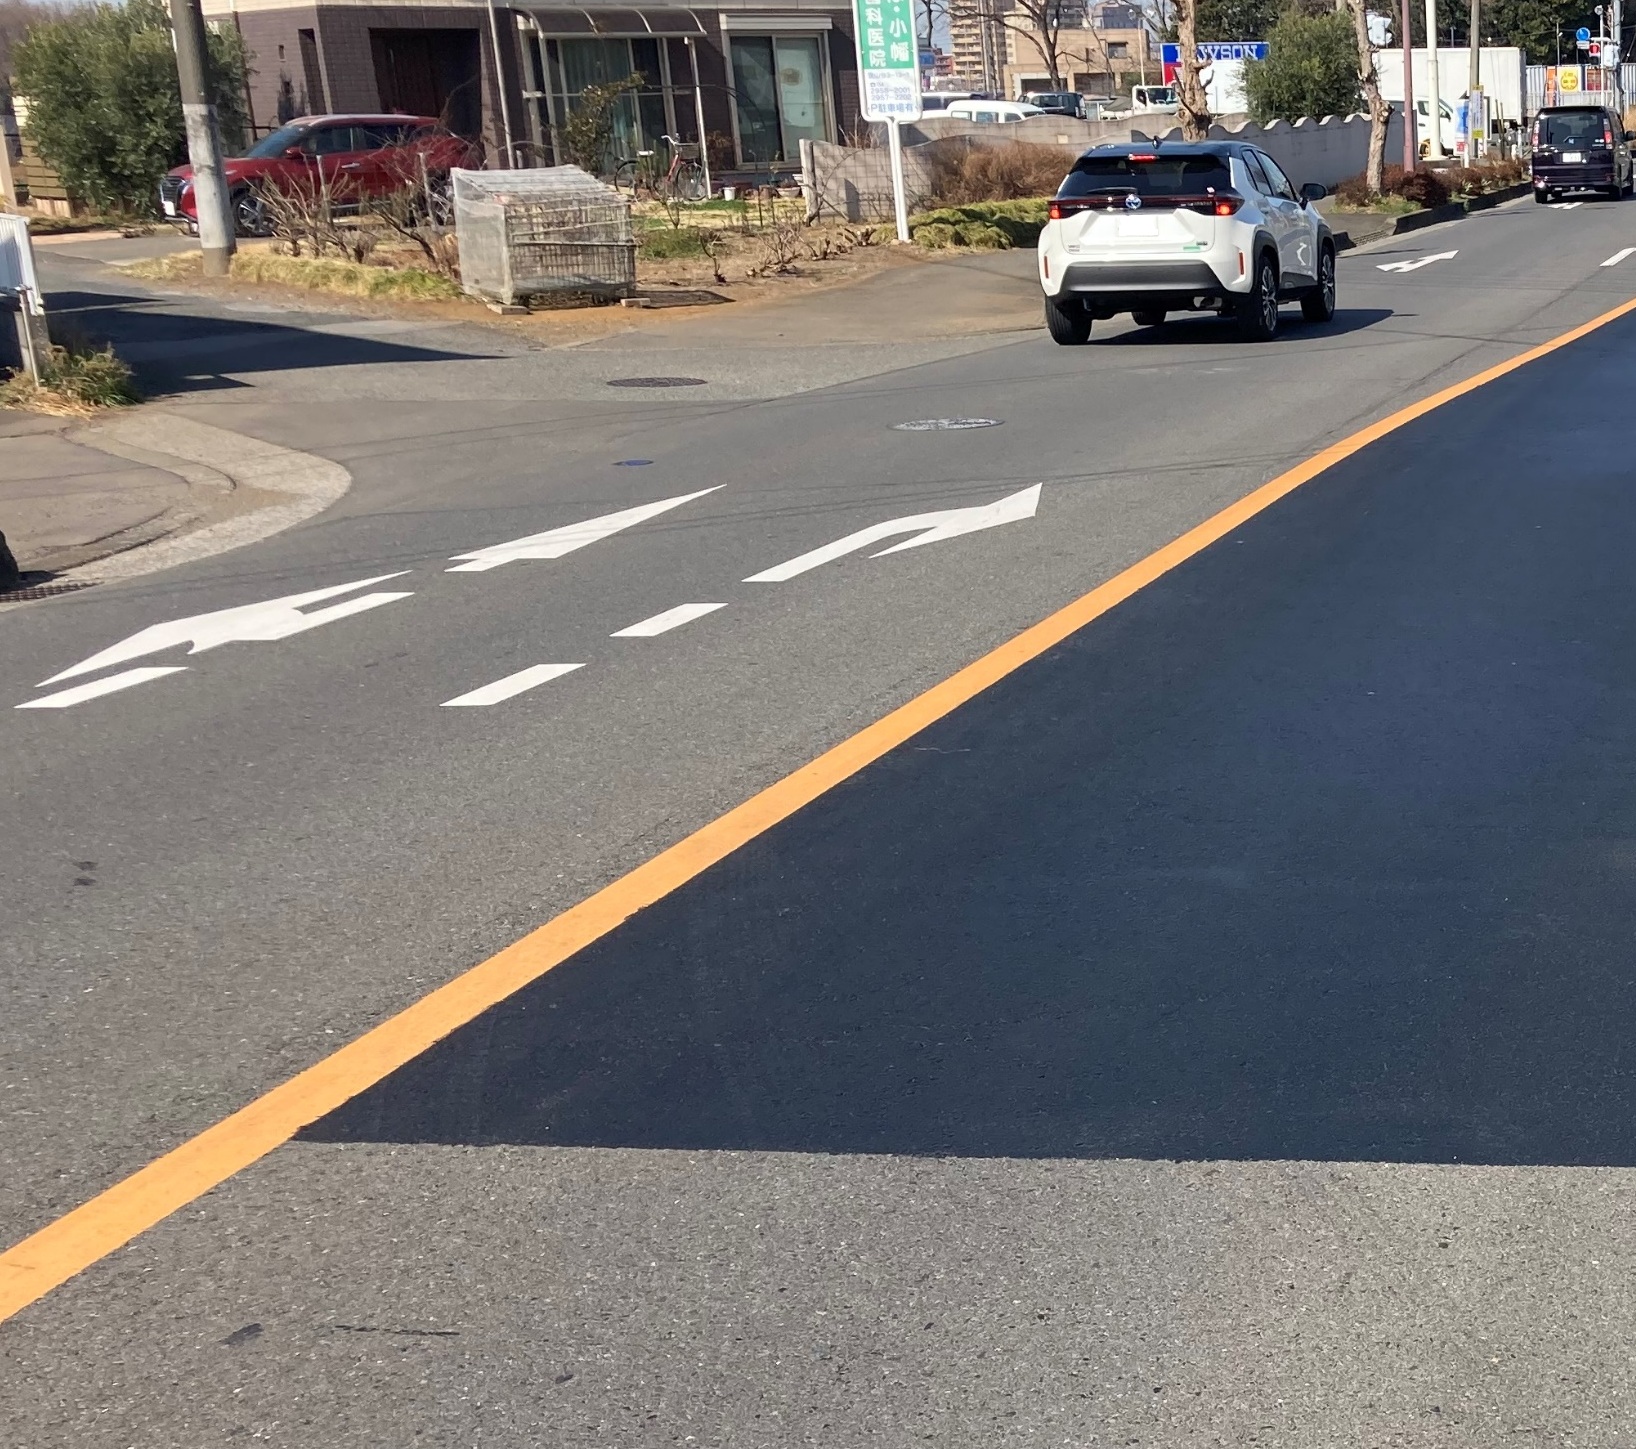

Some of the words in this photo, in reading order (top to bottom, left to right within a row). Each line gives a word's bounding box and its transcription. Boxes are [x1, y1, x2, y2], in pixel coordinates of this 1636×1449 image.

[865, 0, 887, 68] 科医院
[887, 0, 910, 62] ・小幡
[1175, 45, 1258, 60] WSON
